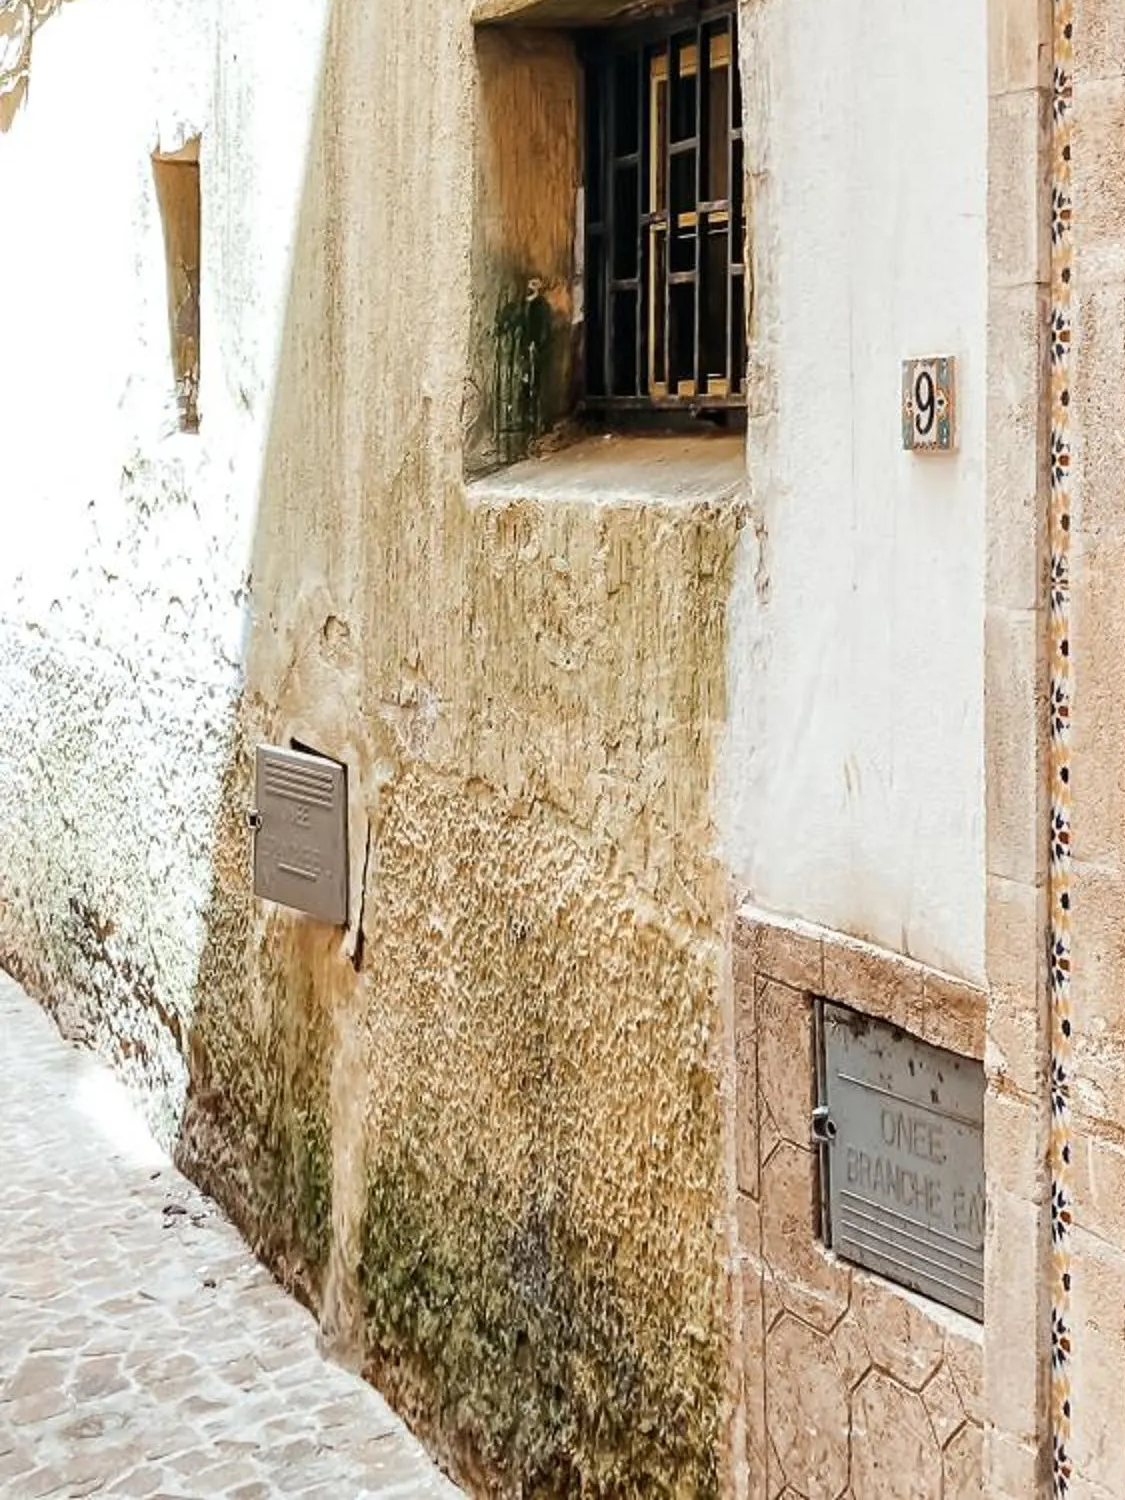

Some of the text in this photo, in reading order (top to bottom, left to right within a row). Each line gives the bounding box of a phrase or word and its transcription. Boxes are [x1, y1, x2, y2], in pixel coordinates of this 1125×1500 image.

[915, 371, 935, 435] 9
[881, 1109, 944, 1165] ONEE
[847, 1148, 942, 1219] BRANCHE
